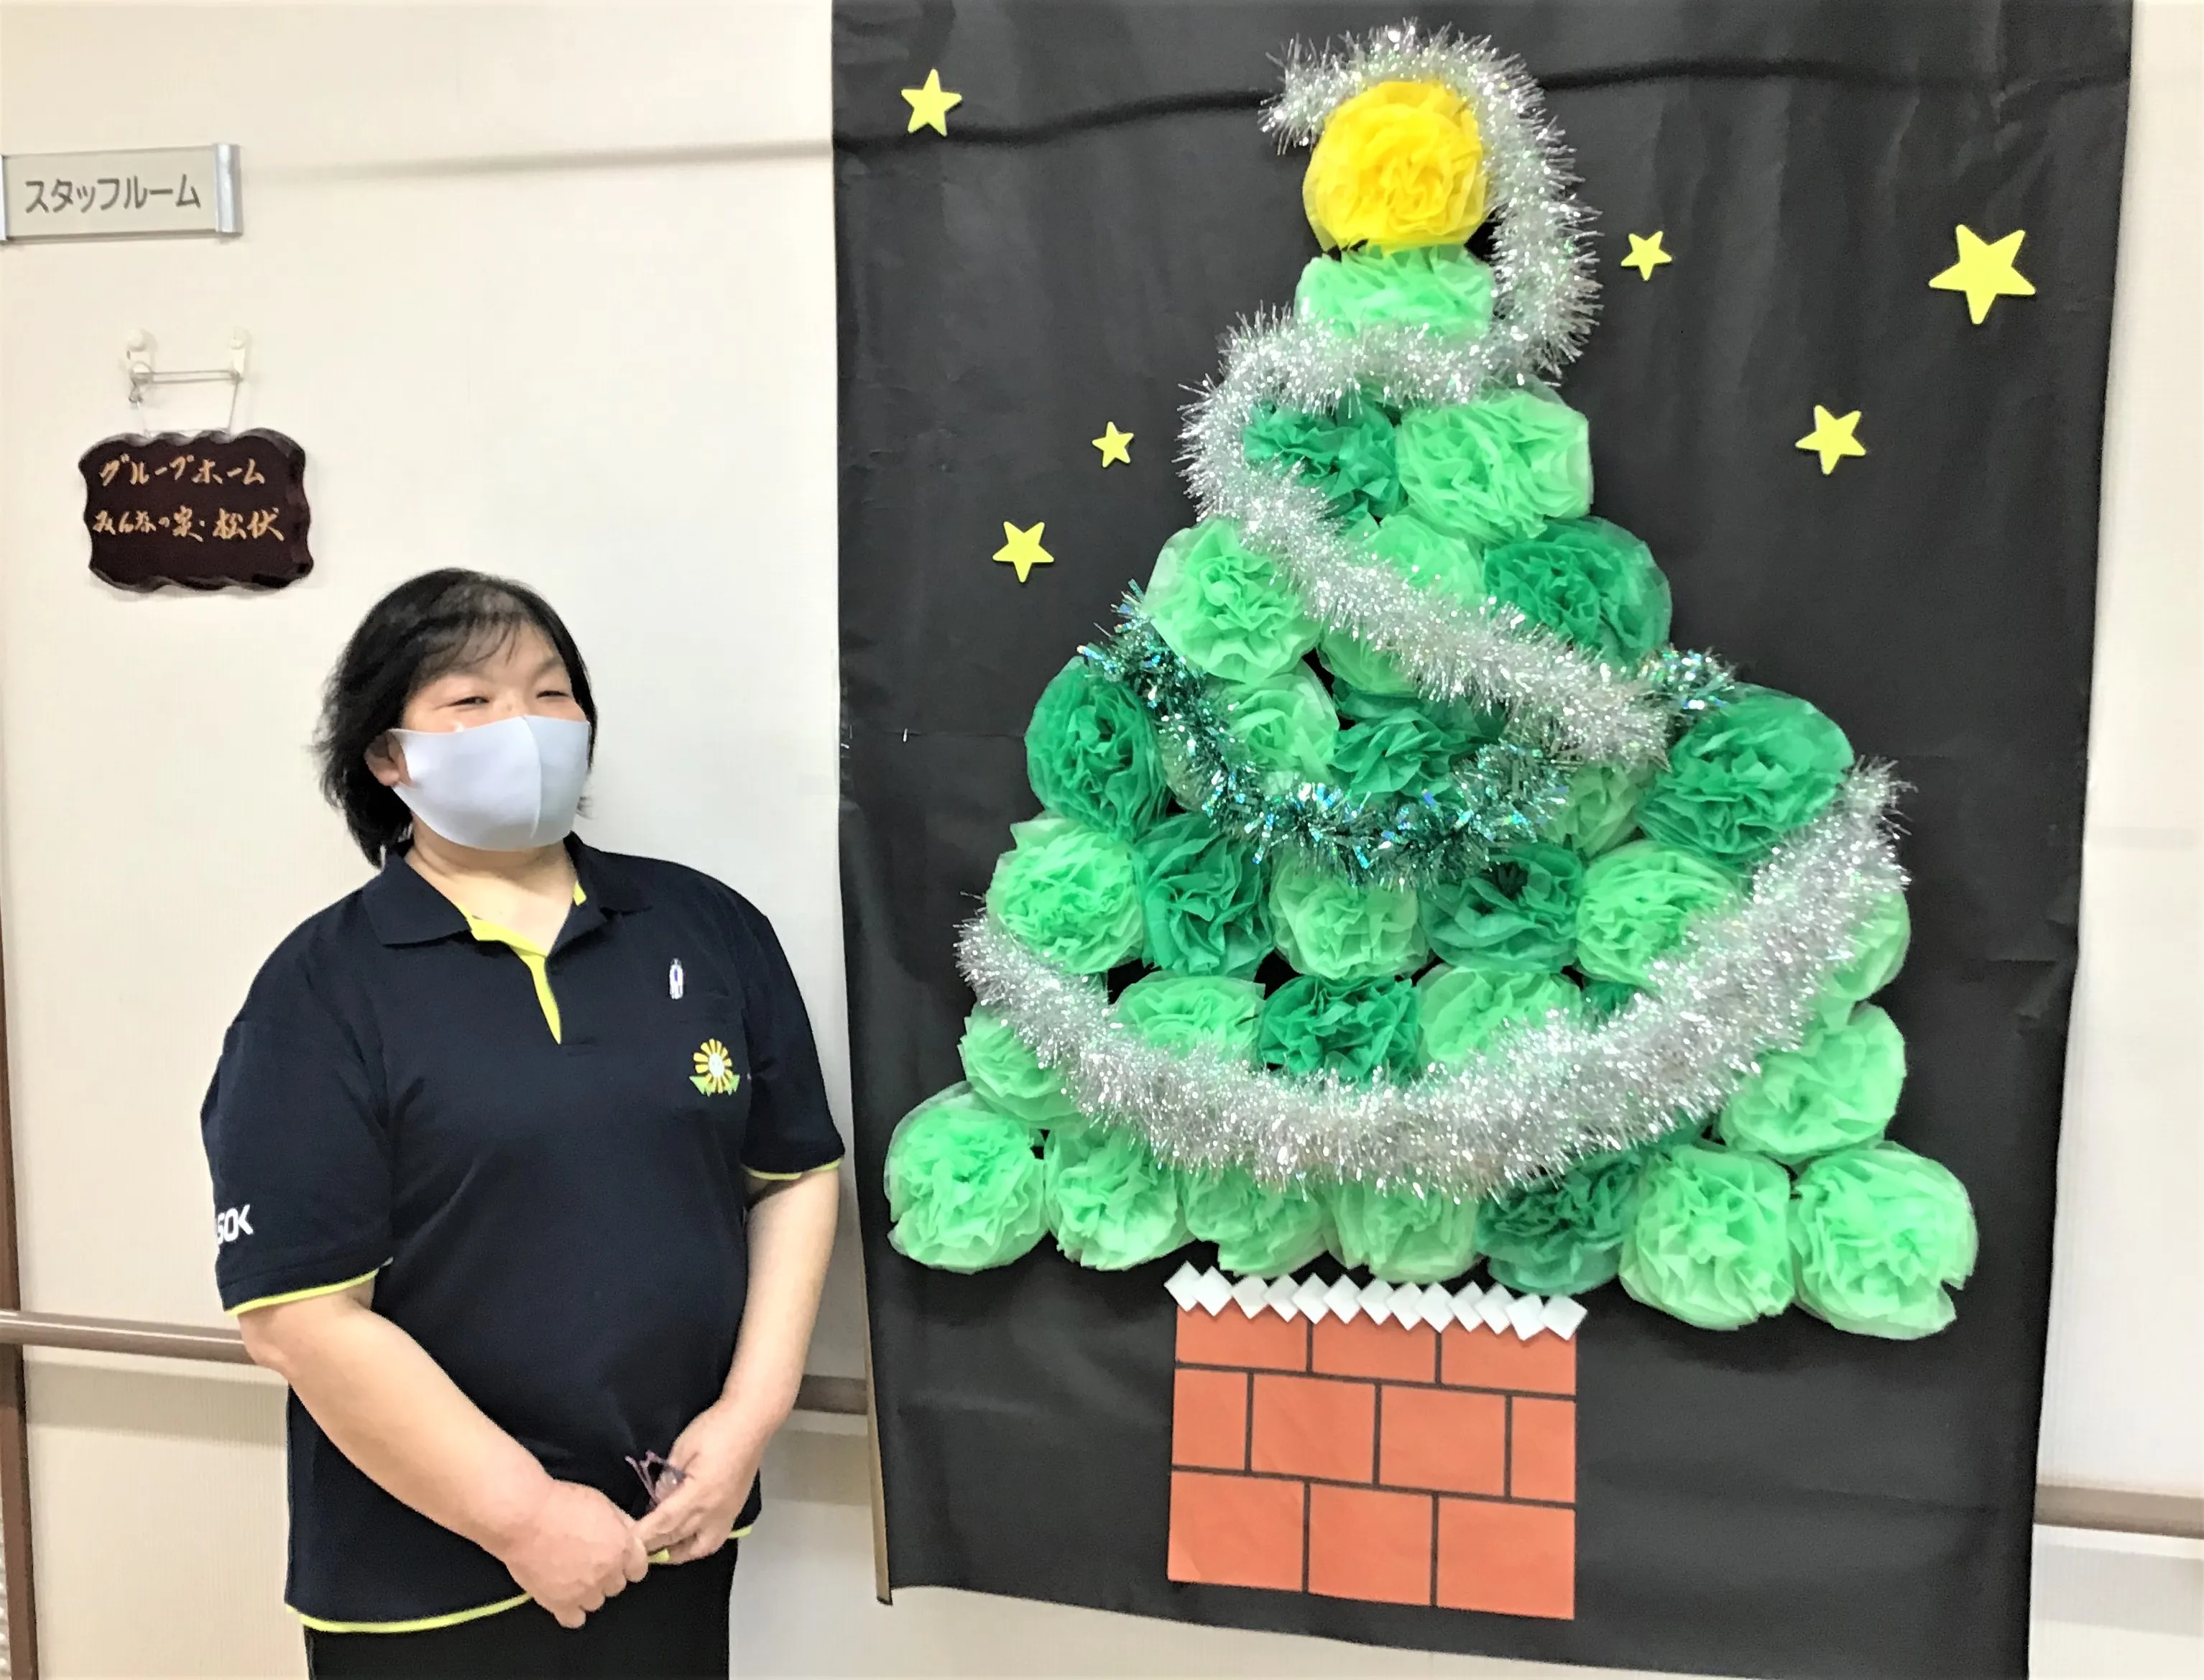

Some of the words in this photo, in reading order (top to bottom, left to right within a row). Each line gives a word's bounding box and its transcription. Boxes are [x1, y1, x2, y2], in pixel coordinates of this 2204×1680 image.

[25, 174, 201, 213] スタッフルーム
[98, 453, 265, 486] グループホーム
